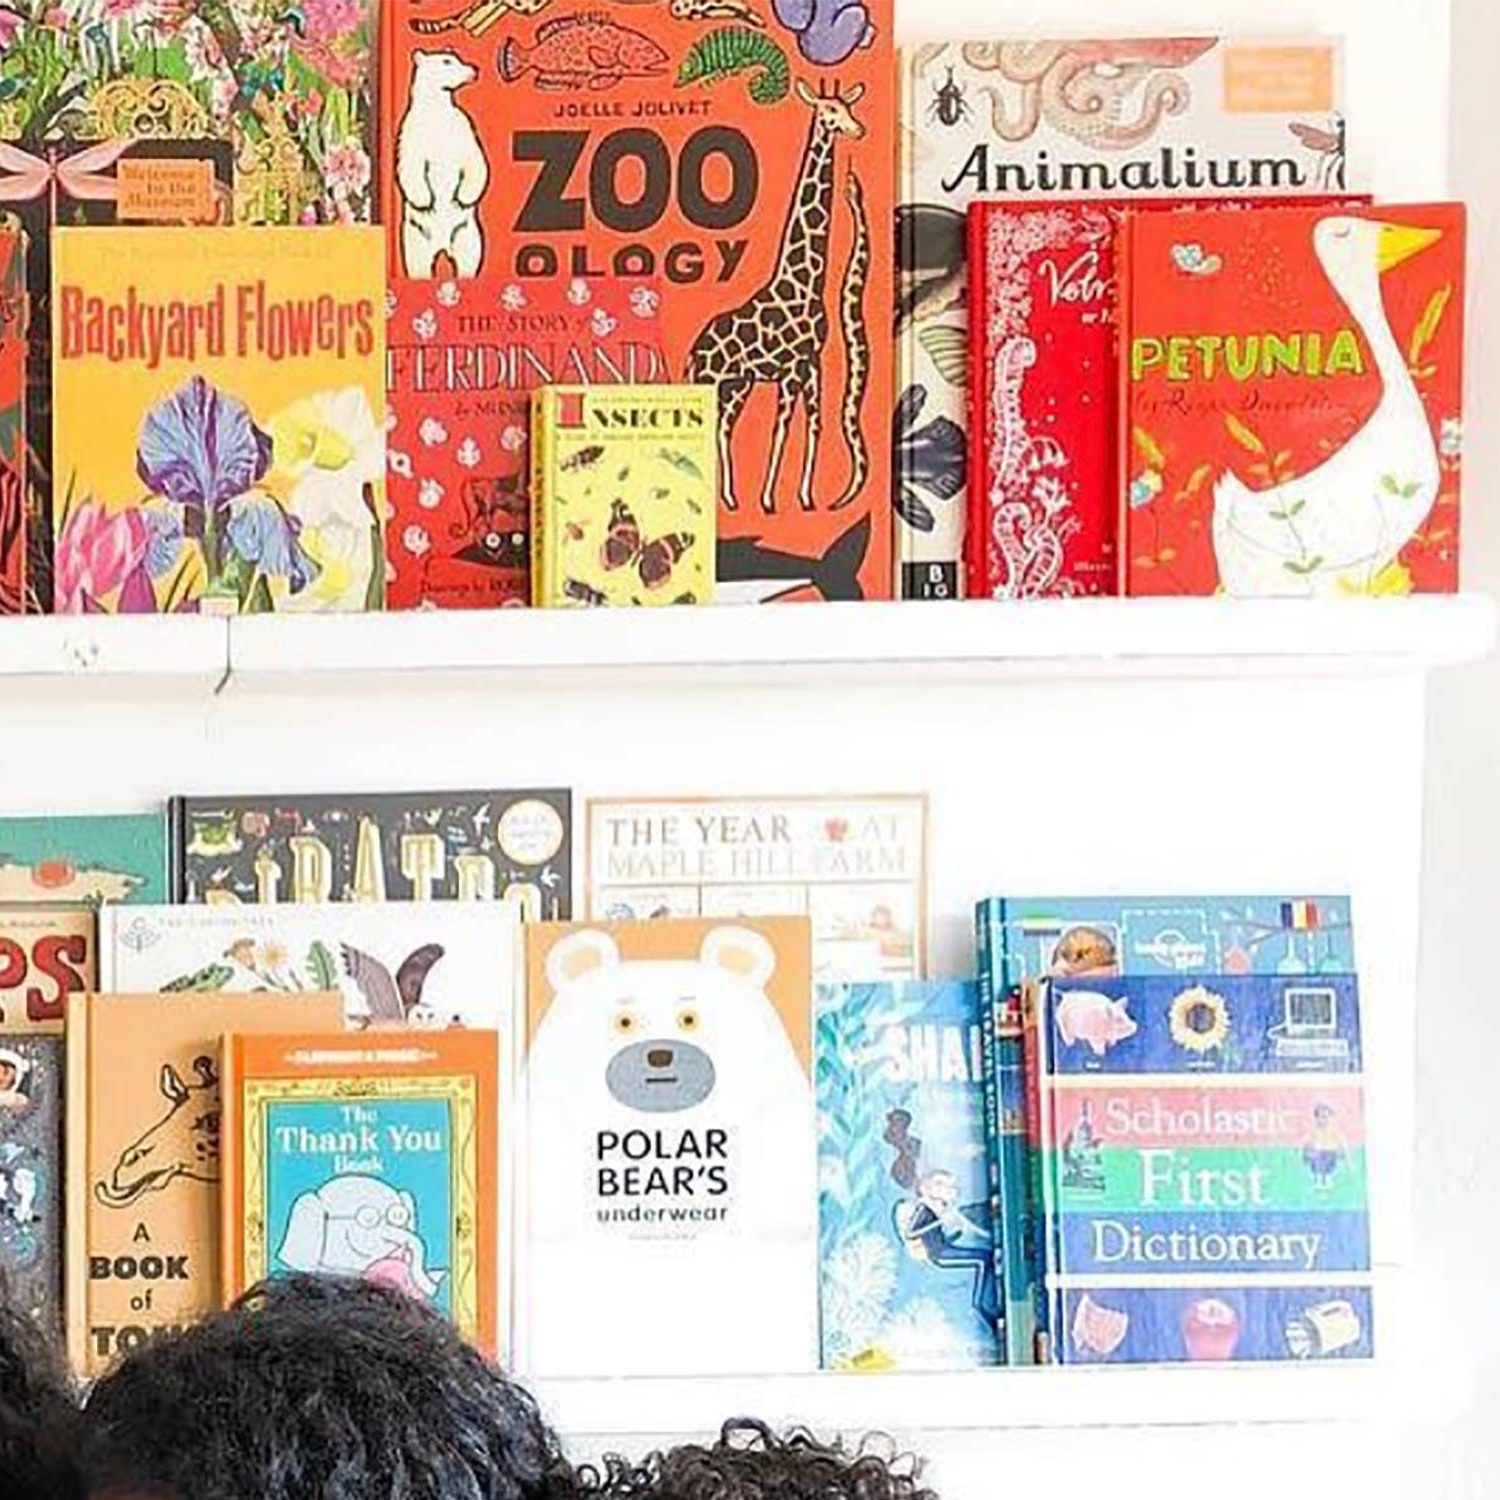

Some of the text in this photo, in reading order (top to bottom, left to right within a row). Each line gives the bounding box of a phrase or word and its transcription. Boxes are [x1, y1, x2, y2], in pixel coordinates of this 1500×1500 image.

[631, 99, 714, 117] JOLIVET
[511, 124, 760, 233] ZOO
[941, 143, 1306, 192] Animalium
[515, 239, 749, 284] OLOGY
[61, 280, 375, 370] Backyard Flowers
[508, 314, 572, 333] STORY
[386, 339, 664, 392] FERDINAND
[1130, 329, 1365, 382] PETUNIA
[605, 813, 900, 847] THE YEAR AT
[607, 848, 715, 878] MAPLE
[730, 847, 794, 877] HILL
[340, 1105, 378, 1122] The
[1105, 1097, 1294, 1135] Scholastic
[275, 1124, 442, 1153] Thank You
[597, 1128, 729, 1161] POLAR
[334, 1153, 385, 1174] Book
[1140, 1148, 1271, 1207] First
[597, 1165, 729, 1197] BEAR'S
[596, 1203, 729, 1222] underwear
[133, 1222, 151, 1243] A
[1091, 1218, 1322, 1271] Dictionary
[89, 1256, 190, 1281] BOOK
[130, 1288, 153, 1311] of
